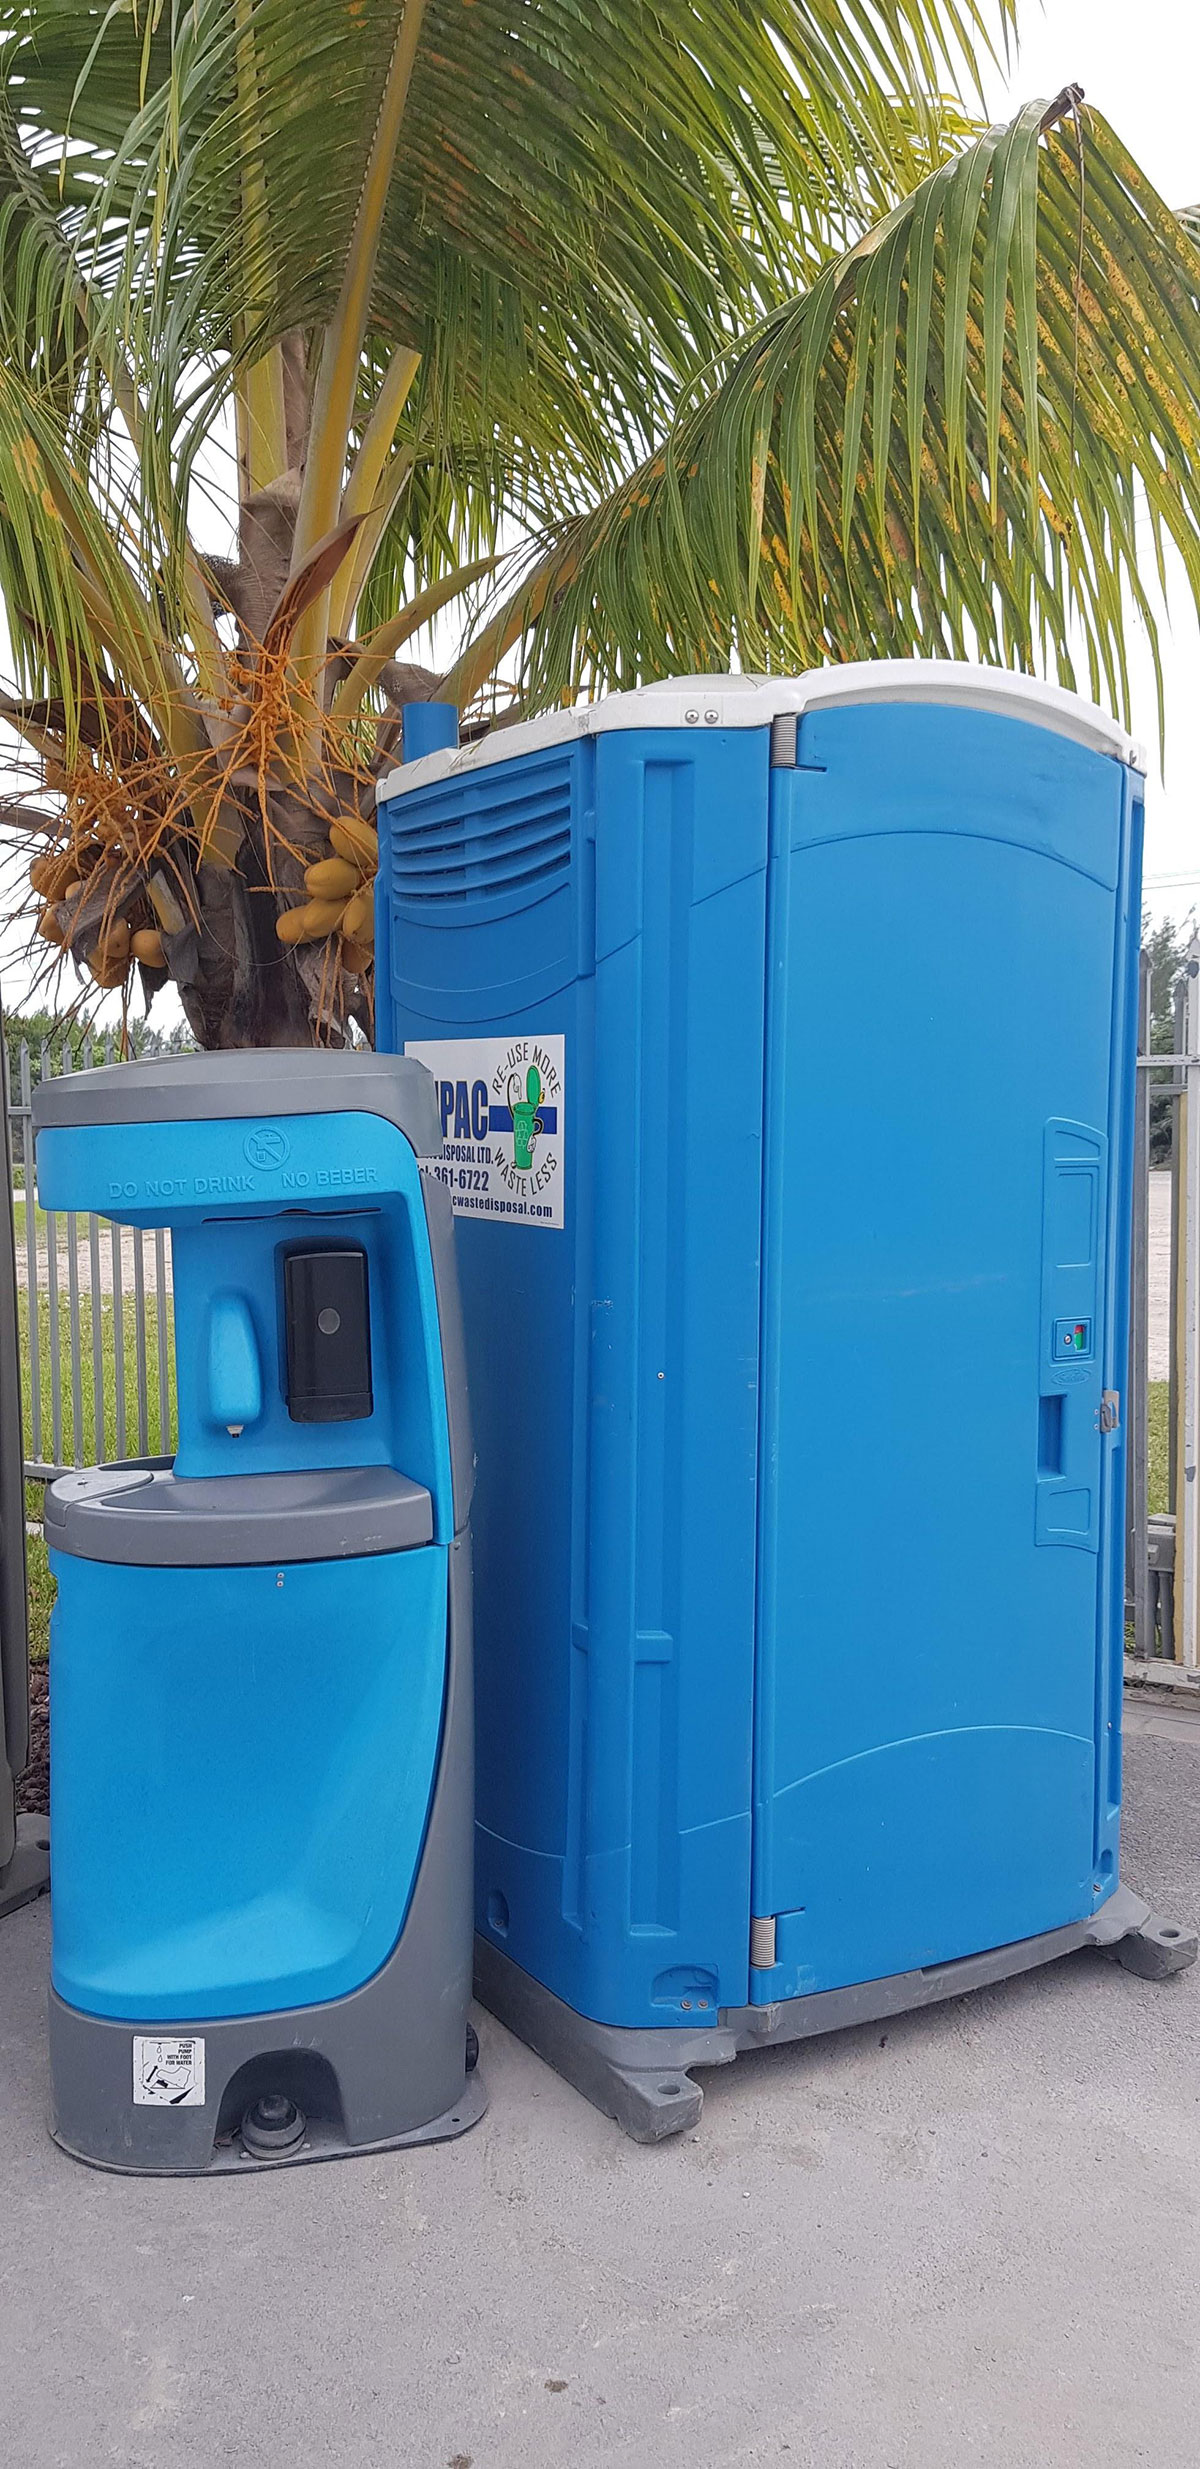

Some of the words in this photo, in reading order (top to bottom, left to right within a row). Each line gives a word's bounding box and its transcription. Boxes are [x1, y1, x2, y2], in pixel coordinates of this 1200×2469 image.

[492, 1042, 529, 1095] RE-USE
[532, 1045, 562, 1099] MORE
[434, 1079, 489, 1141] PAC
[440, 1144, 475, 1163] ISPOSAL
[477, 1146, 494, 1164] LTD.
[494, 1146, 527, 1197] WASTE
[530, 1152, 557, 1195] LESS
[109, 1182, 137, 1198] DO
[146, 1179, 187, 1197] NOT
[194, 1175, 255, 1194] DRINK
[282, 1171, 310, 1189] NO
[316, 1167, 378, 1185] BEBER
[434, 1165, 489, 1192] 361-6722
